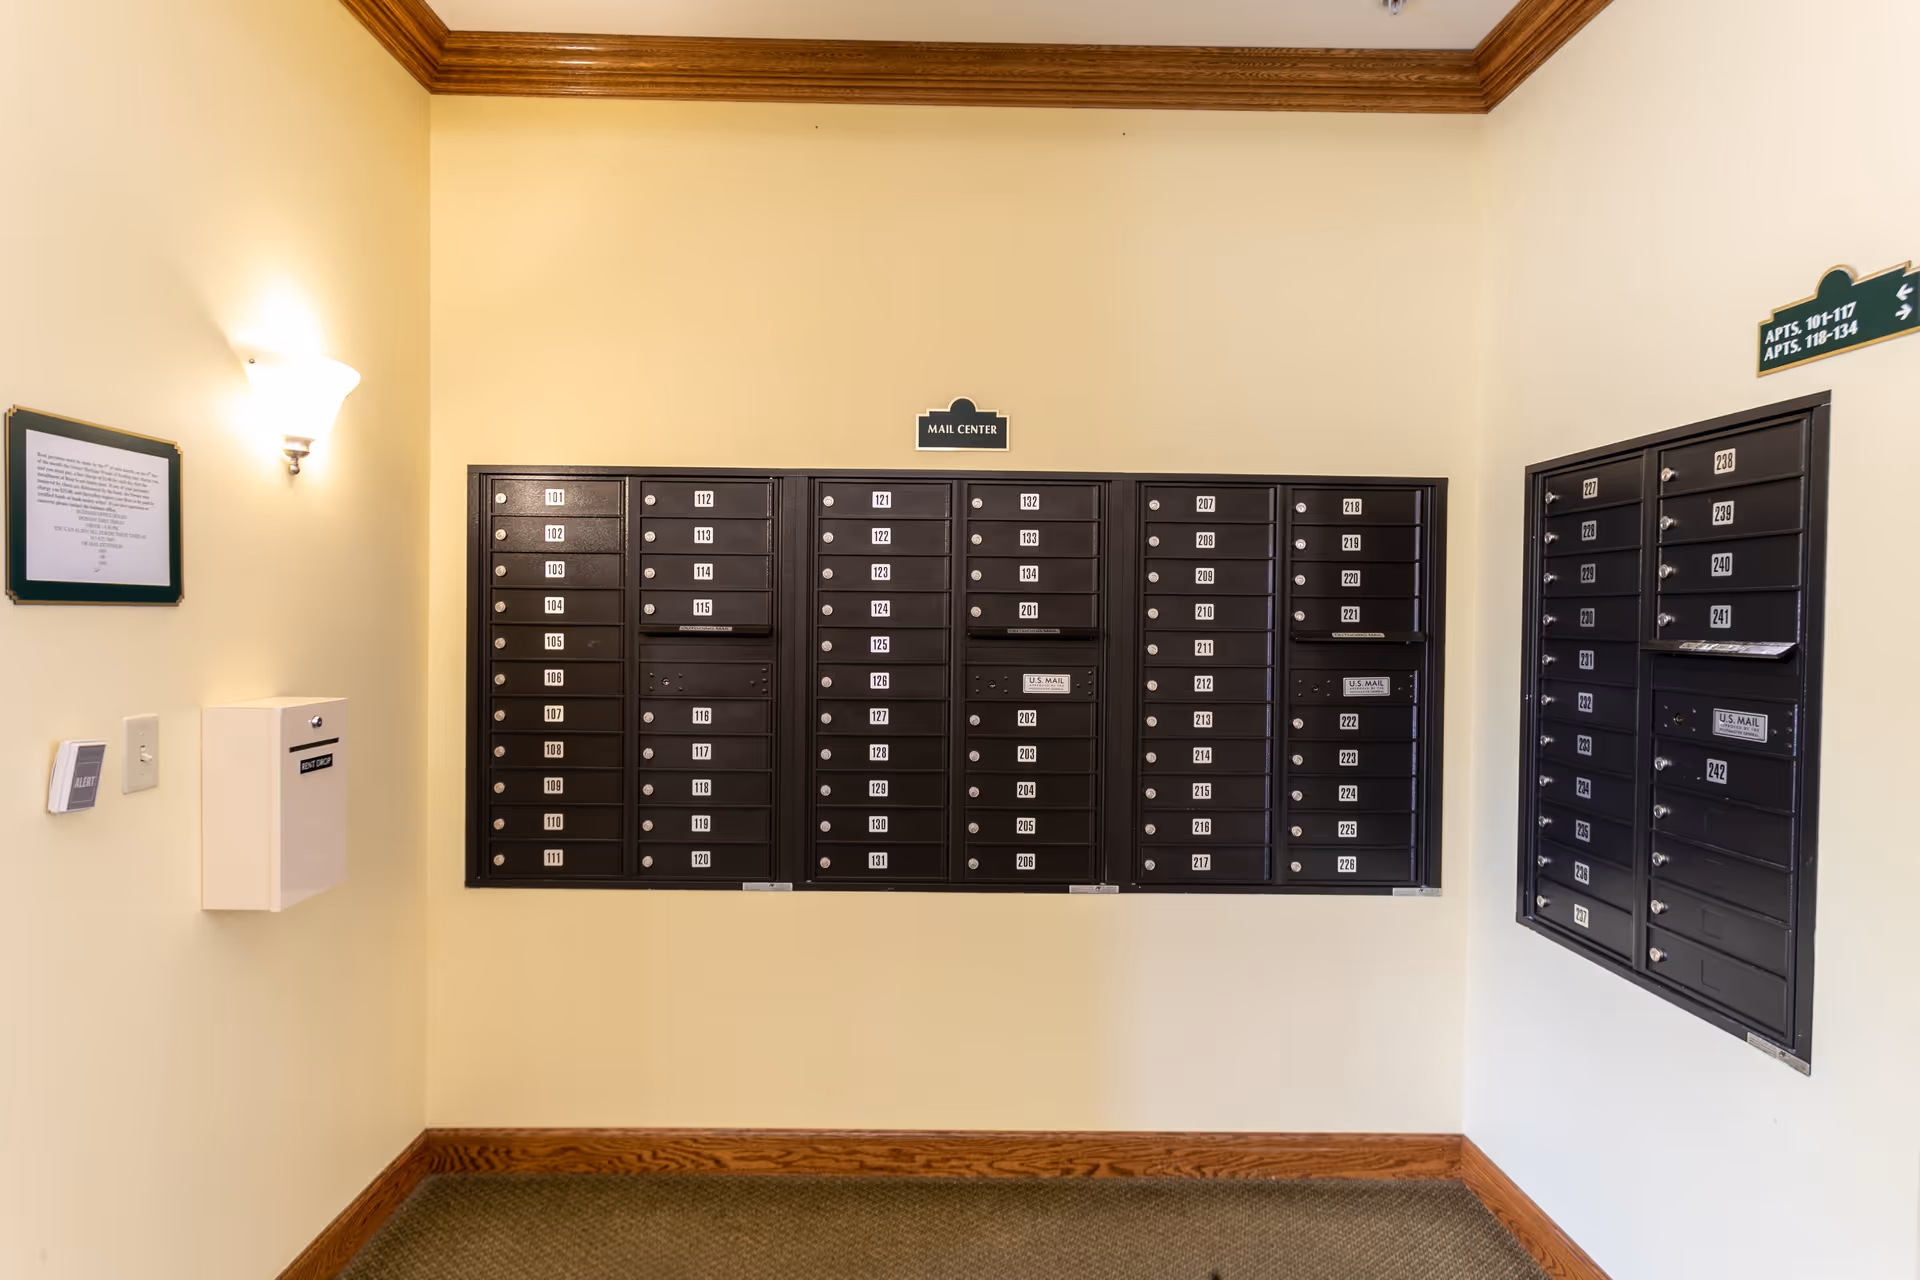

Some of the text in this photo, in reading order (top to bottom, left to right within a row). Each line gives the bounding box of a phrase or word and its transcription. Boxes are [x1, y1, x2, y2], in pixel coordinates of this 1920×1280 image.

[1764, 301, 1857, 344] APTS. 101-117
[1763, 319, 1859, 362] APTS. 118-134
[928, 424, 997, 435] MAIL CENTER
[1716, 452, 1734, 471] 238
[1584, 480, 1597, 497] 227
[547, 490, 563, 503] 101
[697, 493, 712, 505] 112
[875, 494, 889, 506] 121
[1022, 495, 1038, 508] 132
[1198, 497, 1214, 510] 207
[1344, 500, 1360, 513] 218
[1714, 504, 1732, 523] 239
[547, 527, 563, 540] 102
[696, 529, 711, 542] 113
[874, 530, 889, 542] 122
[1582, 523, 1595, 539] 228
[1022, 532, 1037, 544] 133
[1198, 534, 1214, 547] 208
[1343, 536, 1359, 549] 219
[548, 563, 563, 576] 103
[1713, 555, 1731, 573] 240
[696, 566, 711, 578] 114
[873, 566, 889, 579] 123
[1022, 567, 1037, 580] 134
[1197, 569, 1213, 582] 209
[1343, 572, 1359, 585] 220
[1581, 566, 1595, 581] 229
[547, 599, 563, 612] 104
[695, 601, 710, 614] 115
[873, 602, 889, 615] 124
[1021, 604, 1037, 617] 201
[1197, 605, 1213, 618] 210
[1343, 608, 1358, 621] 221
[1581, 610, 1594, 625] 230
[1712, 608, 1729, 625] 241
[546, 635, 562, 648] 105
[873, 638, 888, 651] 125
[1197, 642, 1212, 654] 211
[1580, 652, 1593, 667] 231
[546, 671, 562, 684] 106
[872, 674, 888, 687] 126
[1196, 677, 1212, 690] 212
[1579, 695, 1592, 710] 232
[546, 707, 562, 720] 107
[695, 709, 710, 722] 116
[871, 710, 887, 722] 127
[1019, 711, 1035, 724] 202
[1195, 713, 1211, 726] 213
[1341, 715, 1357, 728] 222
[1719, 713, 1760, 728] U.S. MAIL
[546, 743, 562, 756] 108
[695, 745, 709, 758] 117
[1578, 737, 1591, 753] 233
[872, 746, 887, 759] 128
[1019, 747, 1035, 760] 203
[1194, 749, 1211, 762] 214
[1340, 751, 1357, 764] 223
[301, 756, 332, 771] RENT DROP
[1708, 761, 1726, 781] 242
[73, 776, 96, 789] ALERT
[546, 779, 561, 792] 109
[694, 781, 709, 794] 118
[871, 782, 886, 795] 129
[1577, 779, 1590, 796] 234
[1018, 784, 1034, 796] 204
[1194, 785, 1210, 797] 215
[1340, 787, 1356, 800] 224
[546, 816, 561, 828] 110
[694, 817, 709, 830] 119
[871, 818, 886, 831] 130
[1018, 819, 1034, 832] 205
[1194, 820, 1210, 833] 216
[1340, 823, 1356, 836] 225
[1577, 822, 1589, 839] 235
[547, 852, 560, 864] 111
[694, 853, 709, 865] 120
[871, 854, 885, 867] 131
[1018, 855, 1034, 868] 206
[1193, 856, 1209, 869] 217
[1339, 858, 1355, 871] 226
[1575, 864, 1588, 882] 236
[1575, 907, 1587, 924] 237
